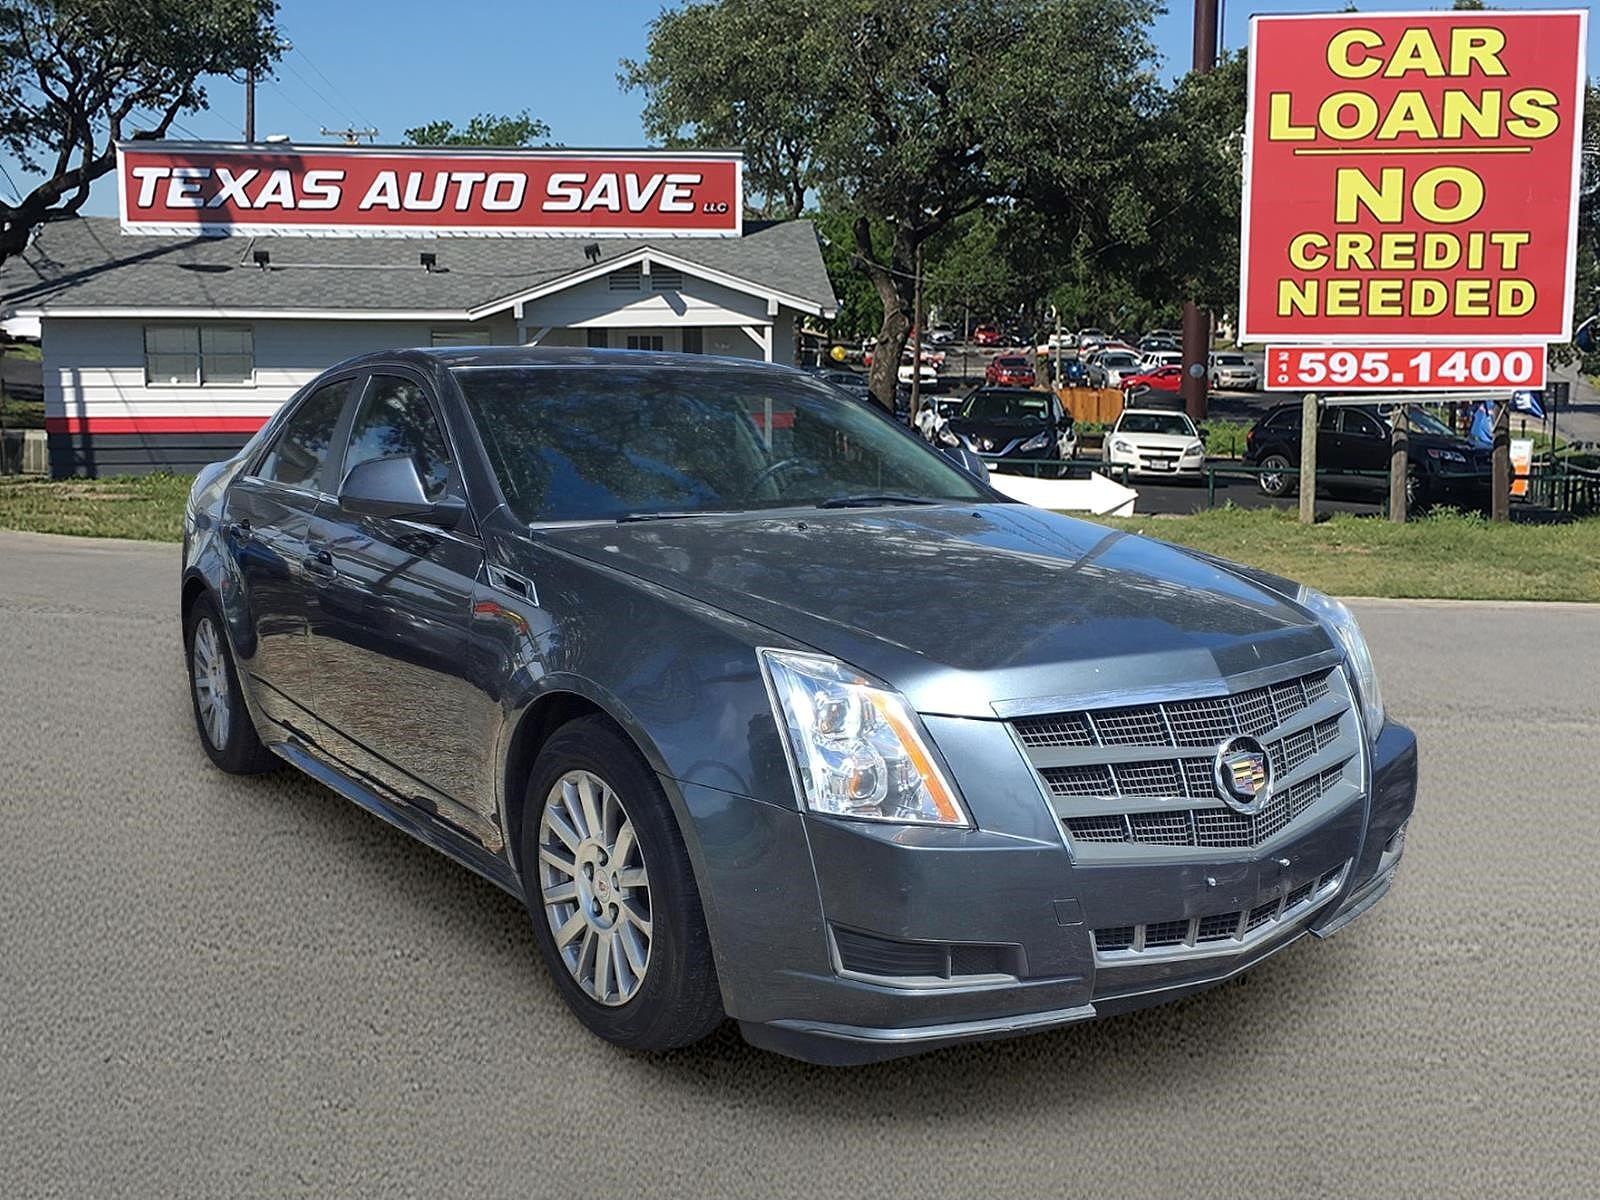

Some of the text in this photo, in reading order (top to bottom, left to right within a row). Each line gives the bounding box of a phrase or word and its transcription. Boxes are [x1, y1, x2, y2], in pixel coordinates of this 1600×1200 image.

[1327, 27, 1509, 78] CAR
[1268, 88, 1560, 141] LOANS
[131, 166, 728, 213] TEXAS AUTO SAVE LLC
[1335, 166, 1485, 224] NO
[1288, 232, 1530, 271] CREDIT
[1277, 279, 1536, 317] NEEDED
[1297, 350, 1534, 384] 595.1400
